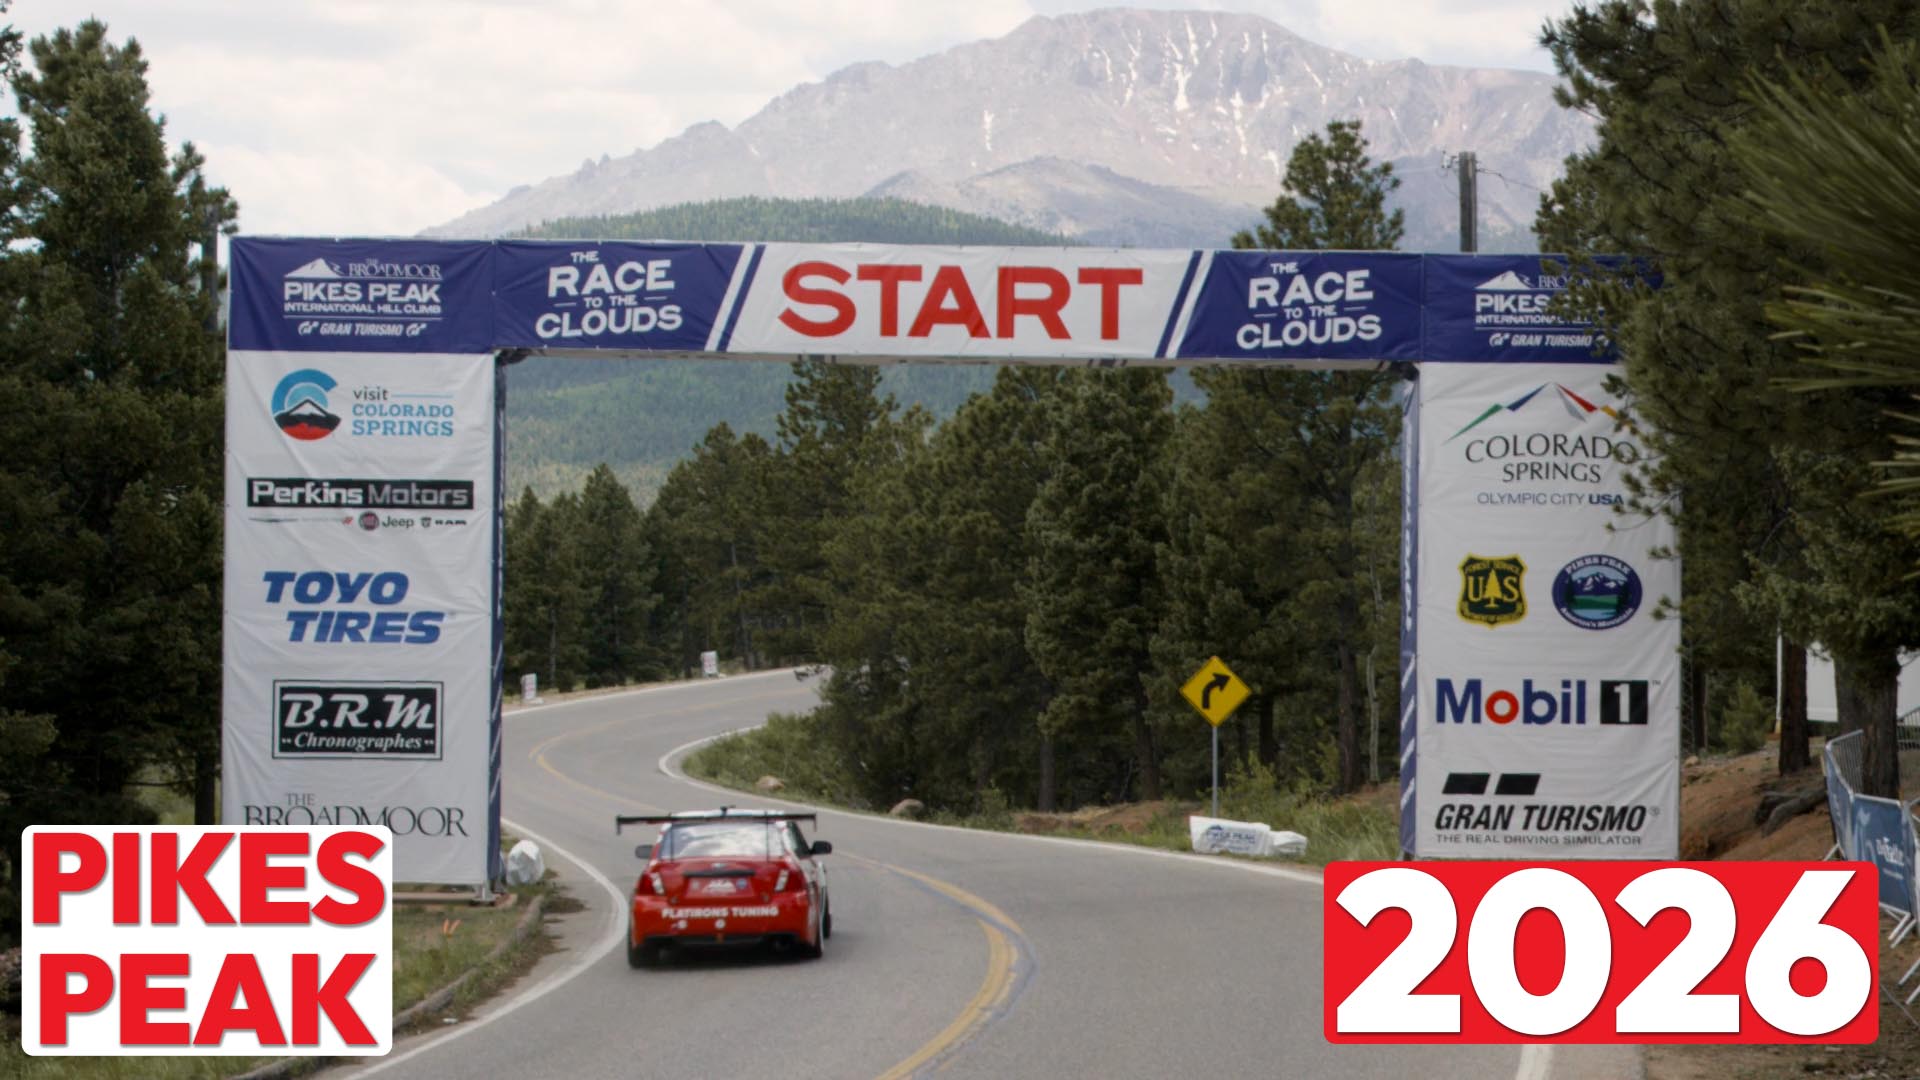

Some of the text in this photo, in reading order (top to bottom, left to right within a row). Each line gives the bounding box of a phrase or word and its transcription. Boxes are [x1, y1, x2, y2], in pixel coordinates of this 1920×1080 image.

[571, 251, 599, 262] THE
[349, 263, 442, 279] BROADMOOR
[1270, 262, 1299, 274] THE
[548, 259, 675, 298] RACE
[284, 282, 441, 303] PIKES PEAK
[1248, 269, 1374, 308] RACE
[284, 302, 441, 314] INTERNATIONAL HILL CLIMB
[583, 295, 638, 309] TO THE
[778, 261, 1143, 340] START
[1475, 293, 1550, 314] PIKES
[535, 304, 683, 339] CLOUDS
[1284, 305, 1337, 320] TO THE
[320, 322, 351, 336] GRAN
[354, 323, 403, 337] TURISMO
[1236, 314, 1382, 350] CLOUDS
[1511, 334, 1542, 346] GRAN
[1545, 334, 1593, 347] TURISMO
[353, 386, 389, 401] visit
[352, 404, 454, 418] COLORADO
[352, 420, 454, 437] SPRINGS
[1465, 433, 1637, 465] COLORADO
[1502, 462, 1602, 484] SPRINGS
[252, 480, 469, 506] Perkins Motors
[1477, 492, 1624, 506] OLYMPIC CITY USA
[381, 516, 415, 528] Jeep
[263, 571, 409, 605] TOYO
[286, 611, 445, 644] TIRES
[1436, 678, 1586, 725] Mobil
[294, 732, 422, 752] Chronographes
[285, 792, 316, 806] THE
[243, 805, 469, 837] BROADMOOR
[1435, 804, 1647, 832] GRAN TURISMO
[1437, 834, 1642, 846] THE REAL DRIVING SIMULATOR
[662, 906, 779, 919] FLATIRONS TUNING
